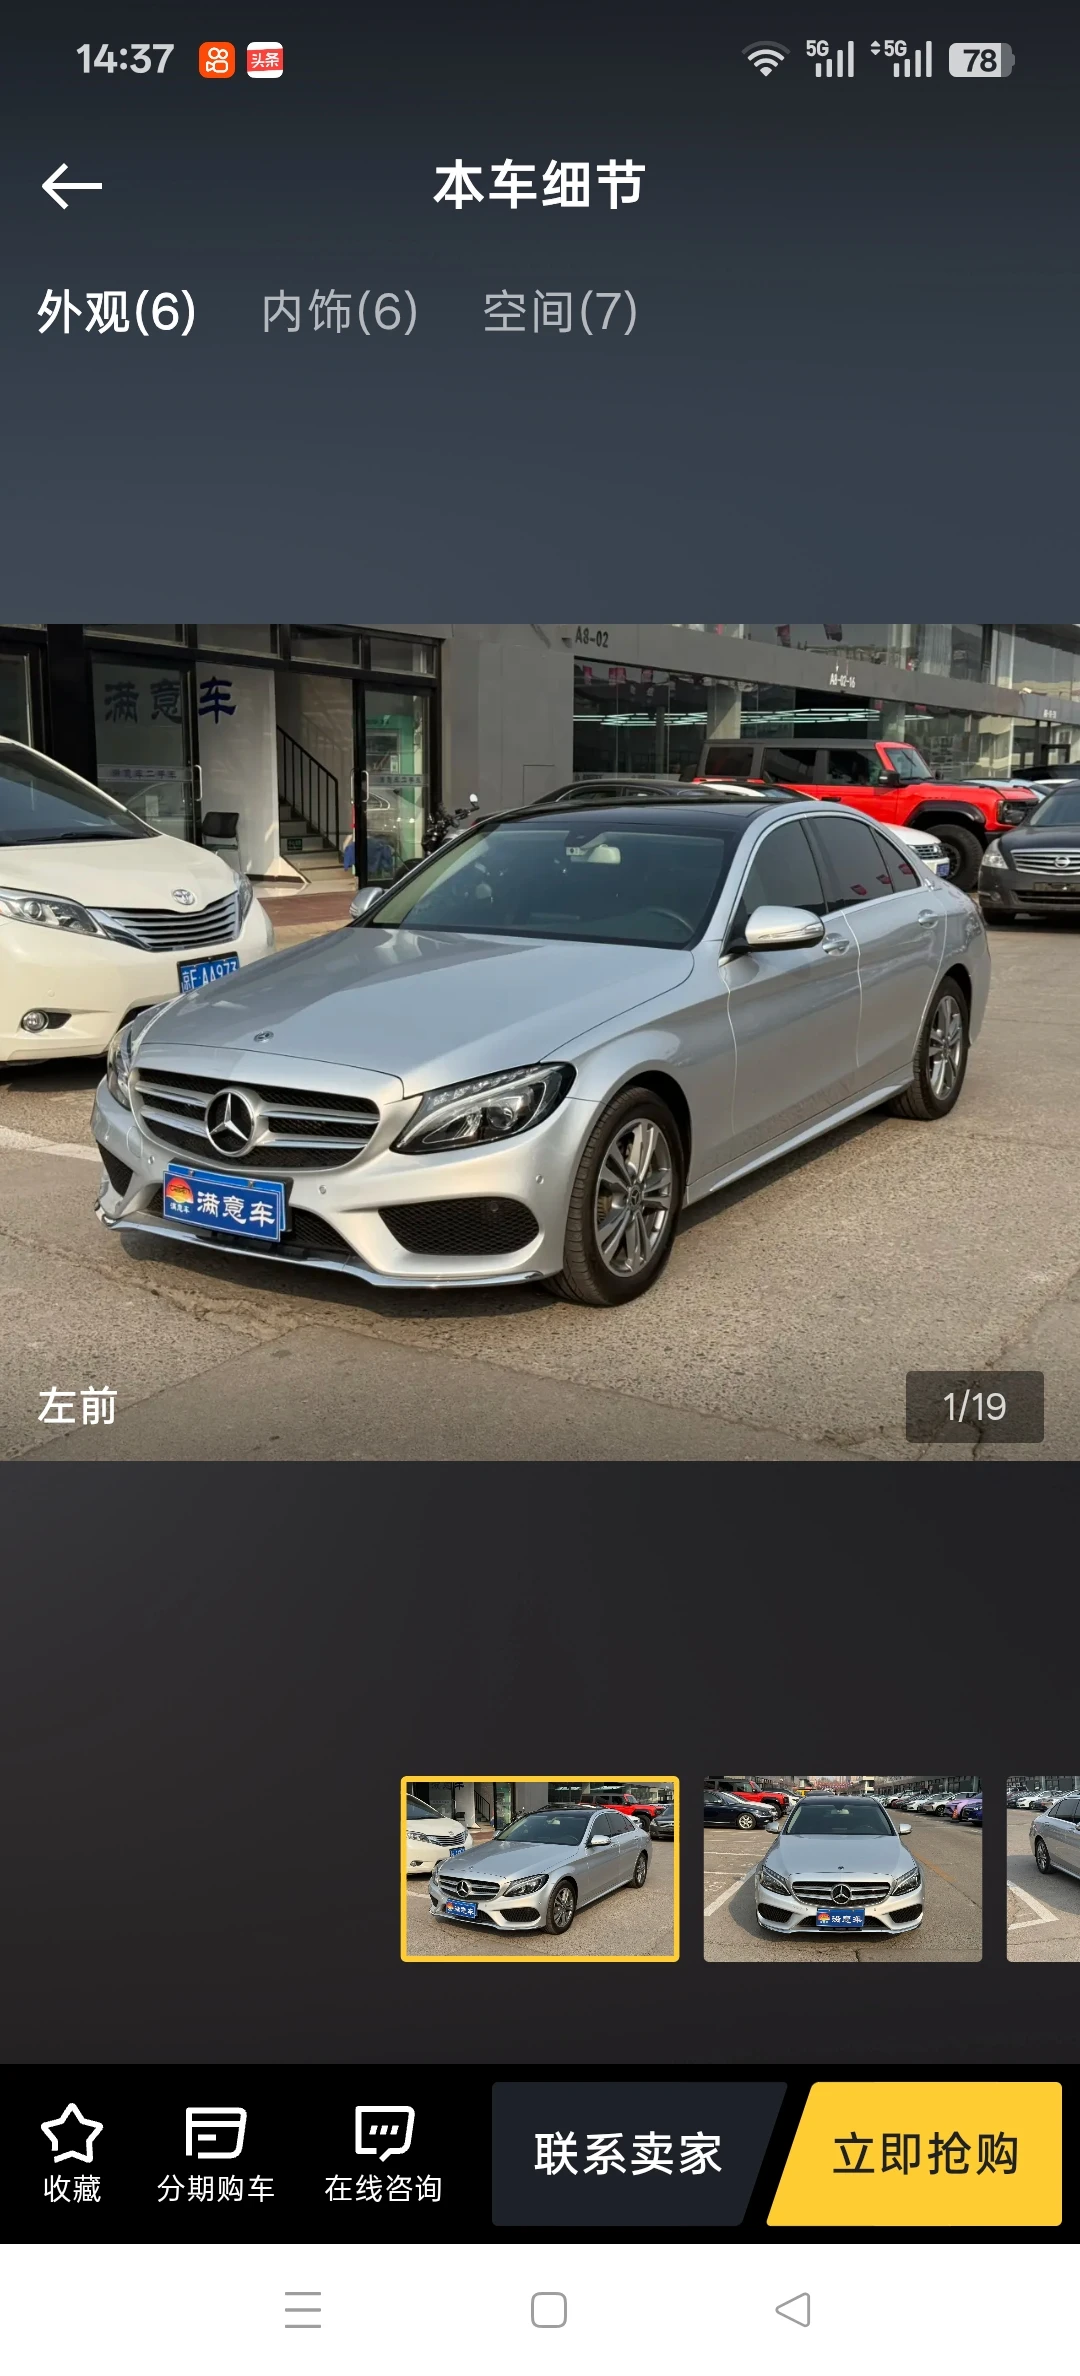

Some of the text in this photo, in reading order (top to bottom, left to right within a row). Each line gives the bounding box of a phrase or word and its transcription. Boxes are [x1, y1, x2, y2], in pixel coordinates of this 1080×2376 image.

[76, 43, 175, 74] 14:37
[251, 52, 279, 69] 头条
[805, 39, 830, 57] 5G
[883, 39, 908, 57] 5G
[963, 48, 998, 73] 78
[432, 157, 646, 210] 本车细节
[36, 288, 197, 337] 外观(6)
[262, 288, 419, 337] 内饰(6)
[483, 288, 639, 336] 空间(7)
[575, 626, 609, 648] A8-02
[104, 676, 237, 724] 满意车
[197, 1191, 276, 1228] 满意车
[533, 2130, 723, 2176] 联系卖家
[832, 2130, 1018, 2176] 立即抢购
[43, 2173, 102, 2204] 收藏
[156, 2173, 275, 2203] 分期购车
[324, 2173, 442, 2203] 在线咨询
